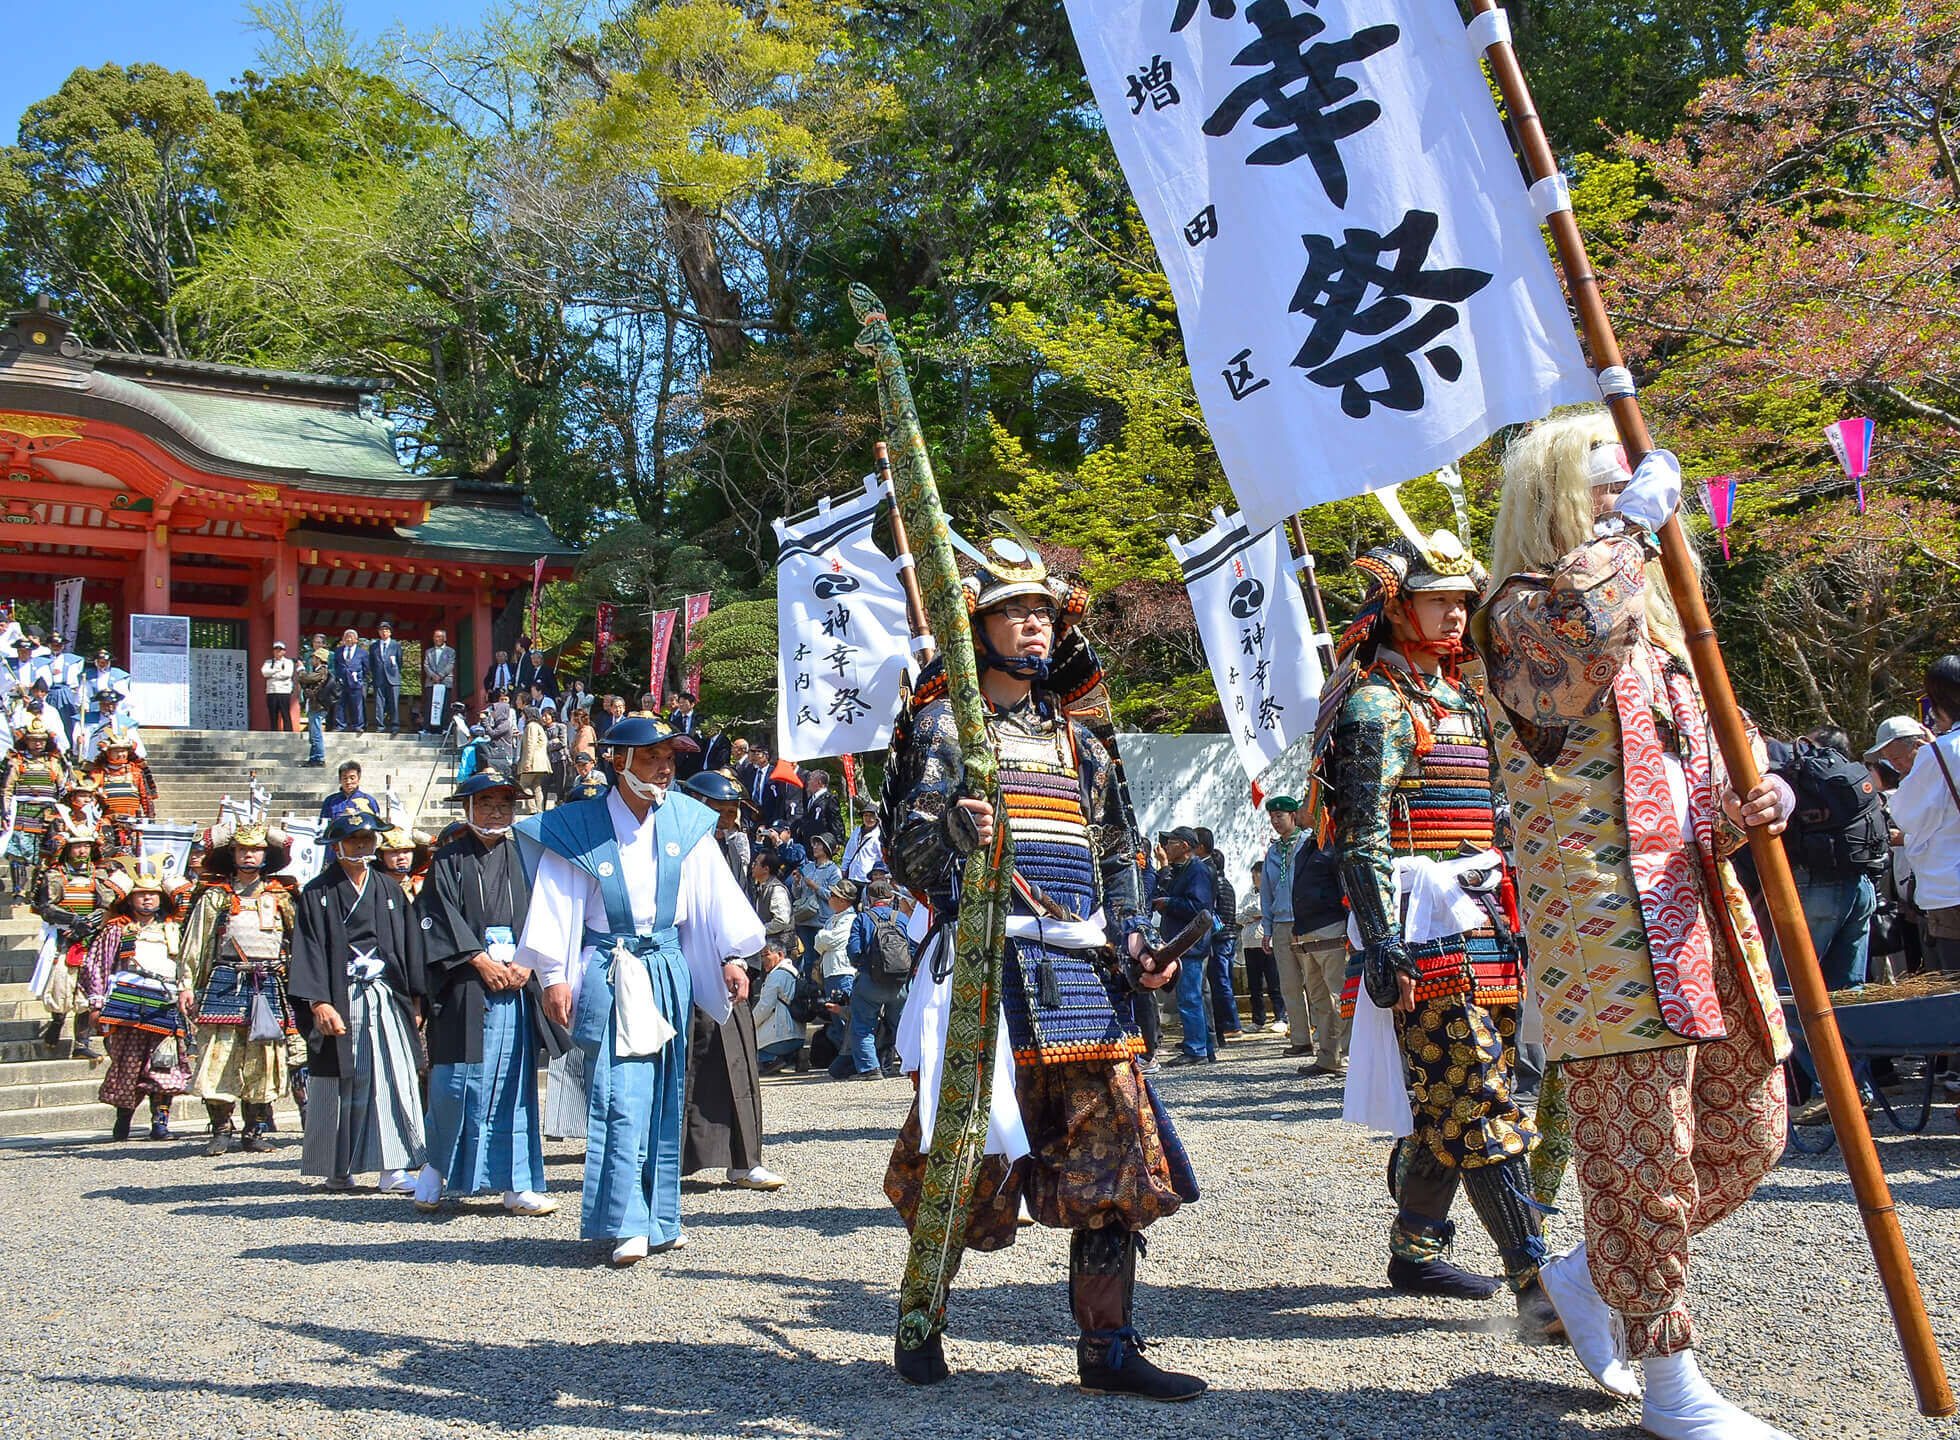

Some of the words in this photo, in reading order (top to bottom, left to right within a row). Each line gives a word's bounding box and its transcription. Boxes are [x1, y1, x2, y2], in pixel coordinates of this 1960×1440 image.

[1126, 54, 1270, 401] 増田区
[1170, 0, 1494, 419] 幸祭
[821, 602, 872, 725] 神幸祭
[1240, 622, 1285, 731] 神幸祭
